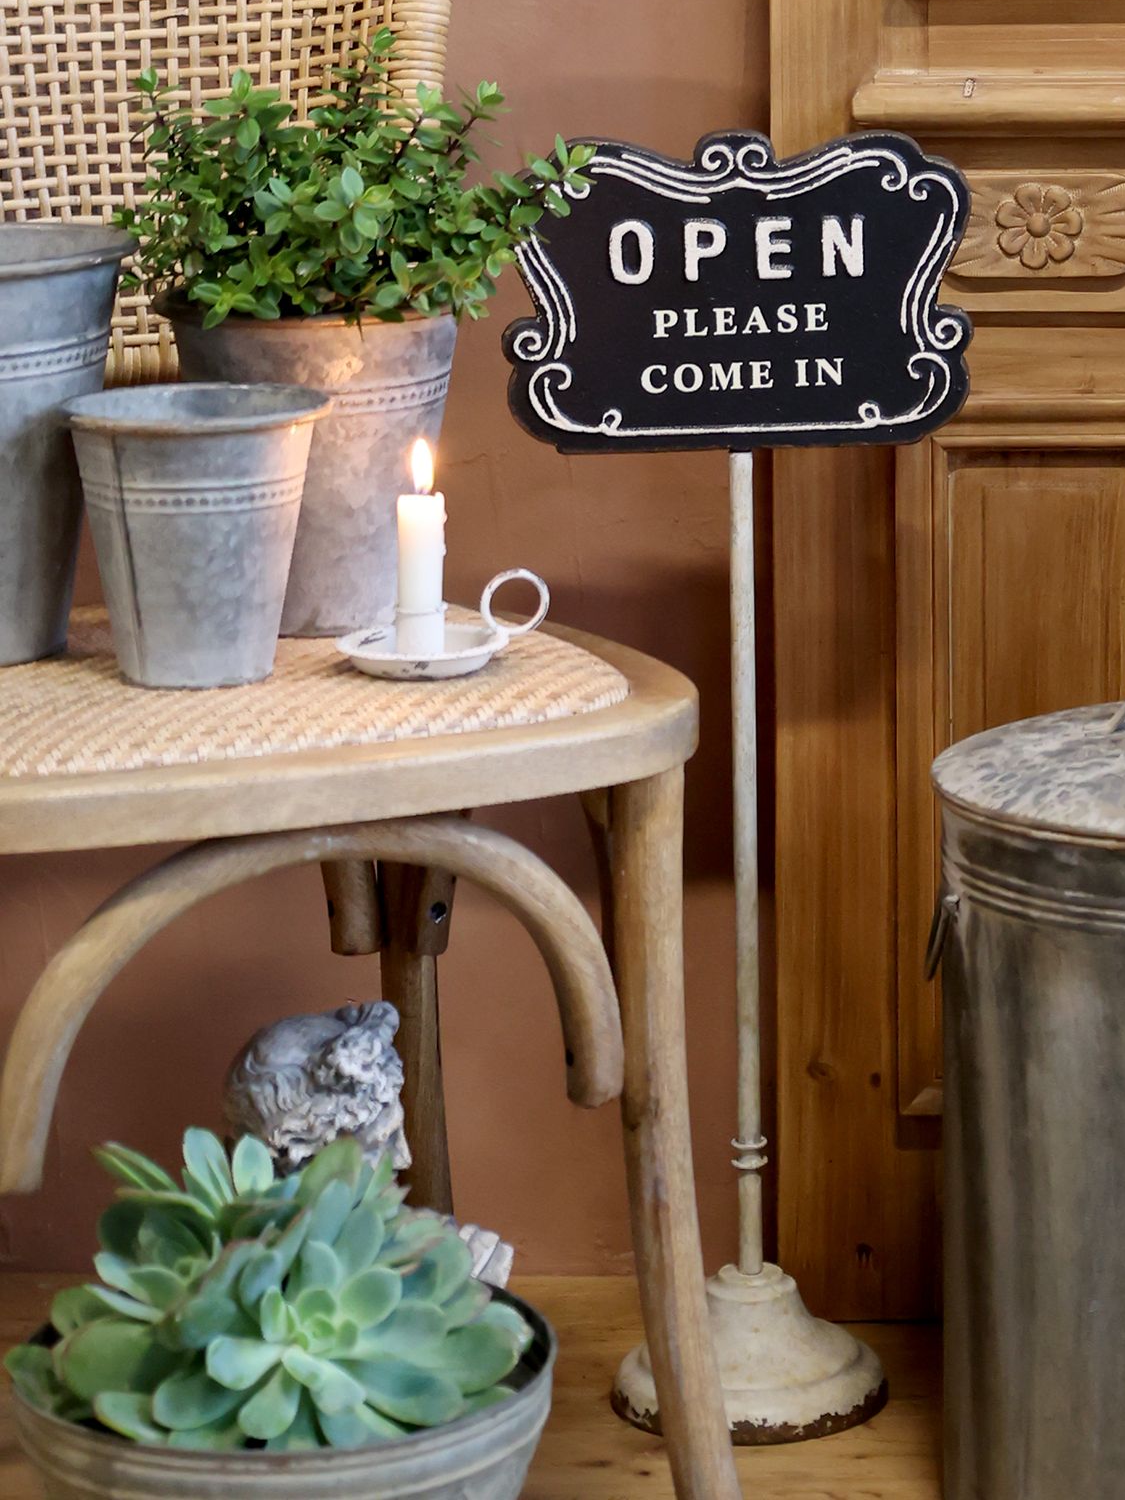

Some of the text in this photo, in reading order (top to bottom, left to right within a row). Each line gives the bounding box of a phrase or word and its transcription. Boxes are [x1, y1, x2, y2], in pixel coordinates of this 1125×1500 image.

[608, 215, 865, 285] OPEN
[652, 303, 830, 339] PLEASE
[640, 357, 844, 394] COME IN
